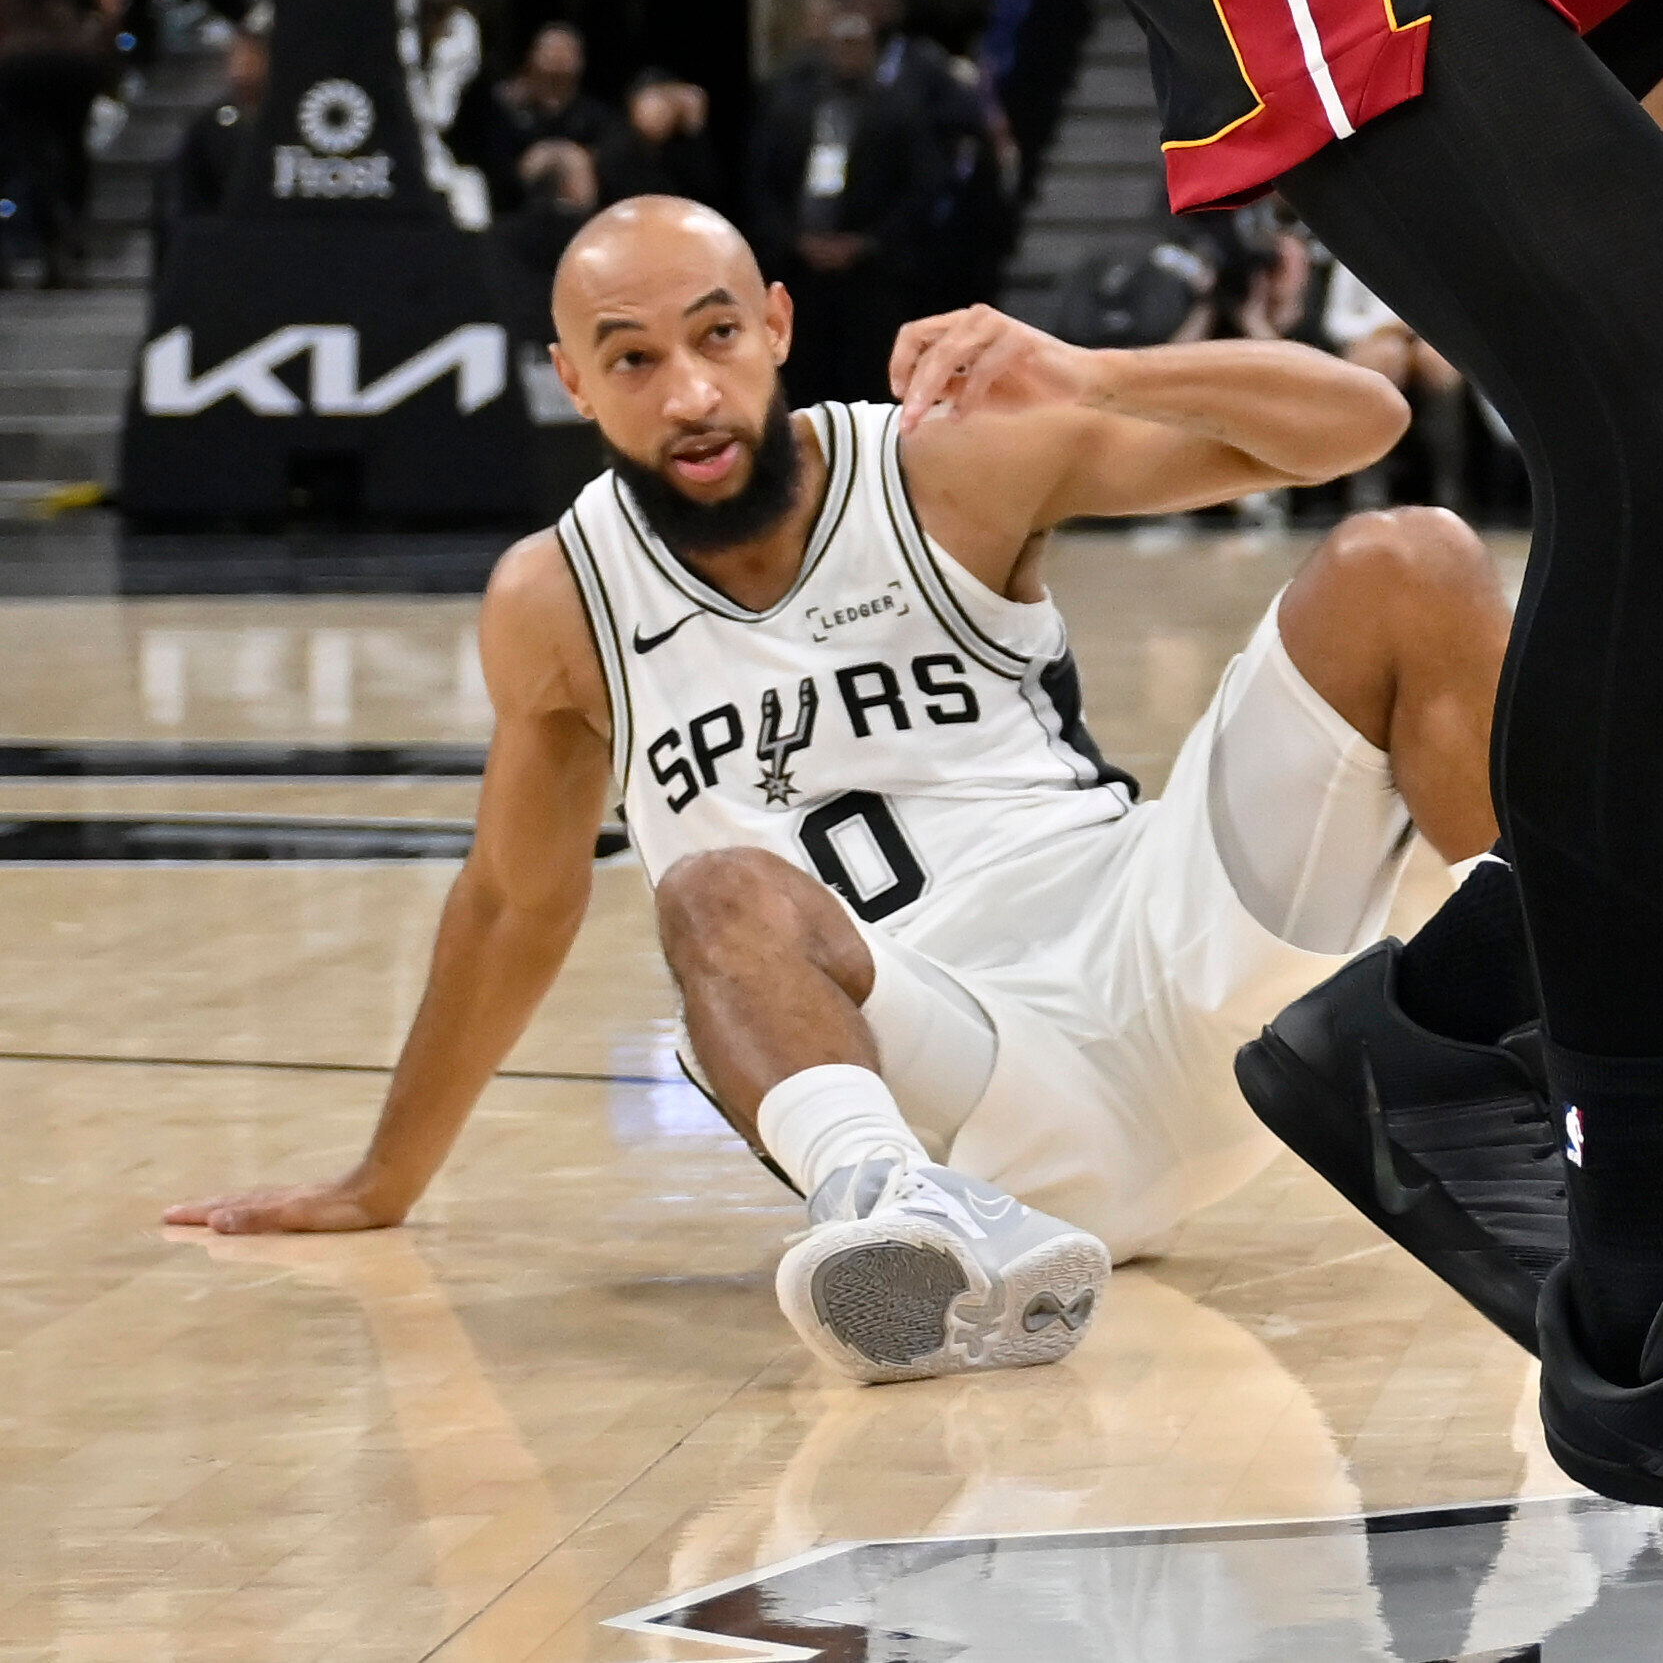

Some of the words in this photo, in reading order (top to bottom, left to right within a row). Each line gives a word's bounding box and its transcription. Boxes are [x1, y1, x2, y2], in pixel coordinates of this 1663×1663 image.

[821, 594, 896, 631] LEDGER
[648, 653, 979, 814] SPURS
[798, 789, 927, 924] 0
